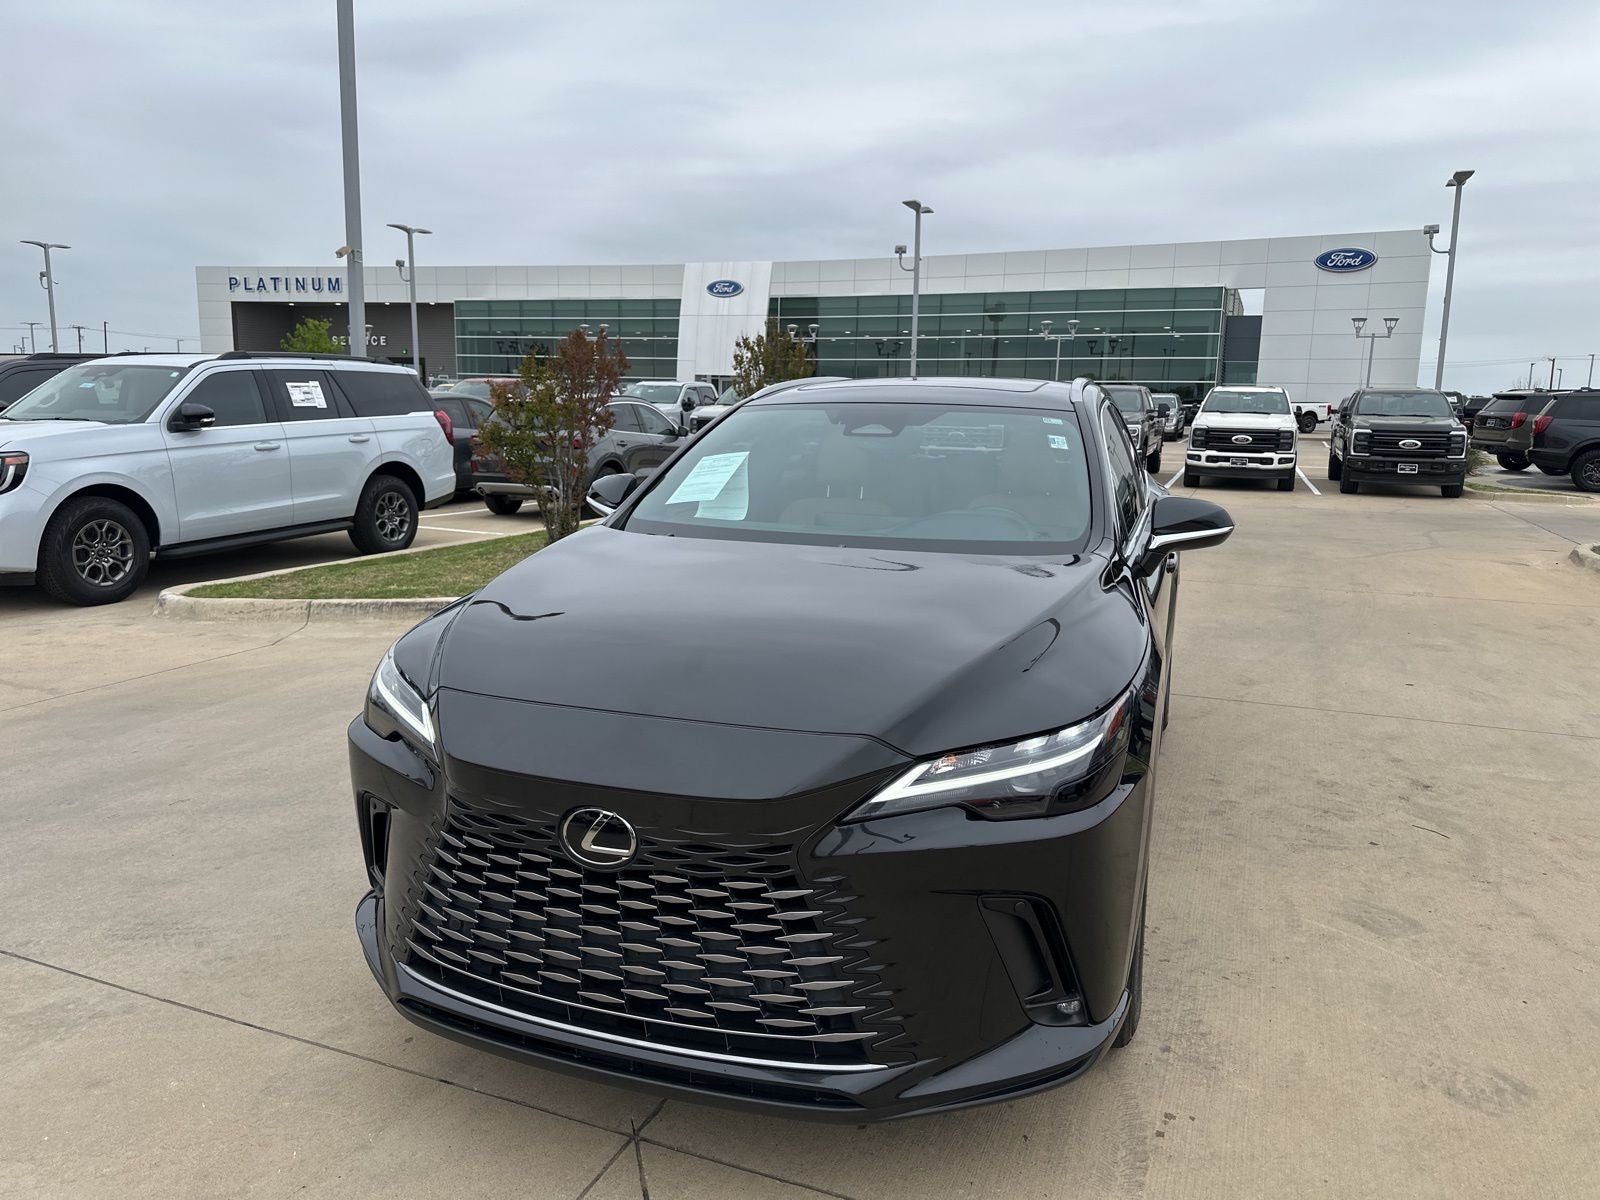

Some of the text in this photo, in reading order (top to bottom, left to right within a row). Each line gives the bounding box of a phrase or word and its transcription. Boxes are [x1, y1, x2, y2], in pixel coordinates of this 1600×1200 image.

[1326, 251, 1363, 267] Ford
[228, 276, 341, 292] PLATINUM
[713, 282, 735, 293] Ford
[331, 335, 387, 346] SEICE
